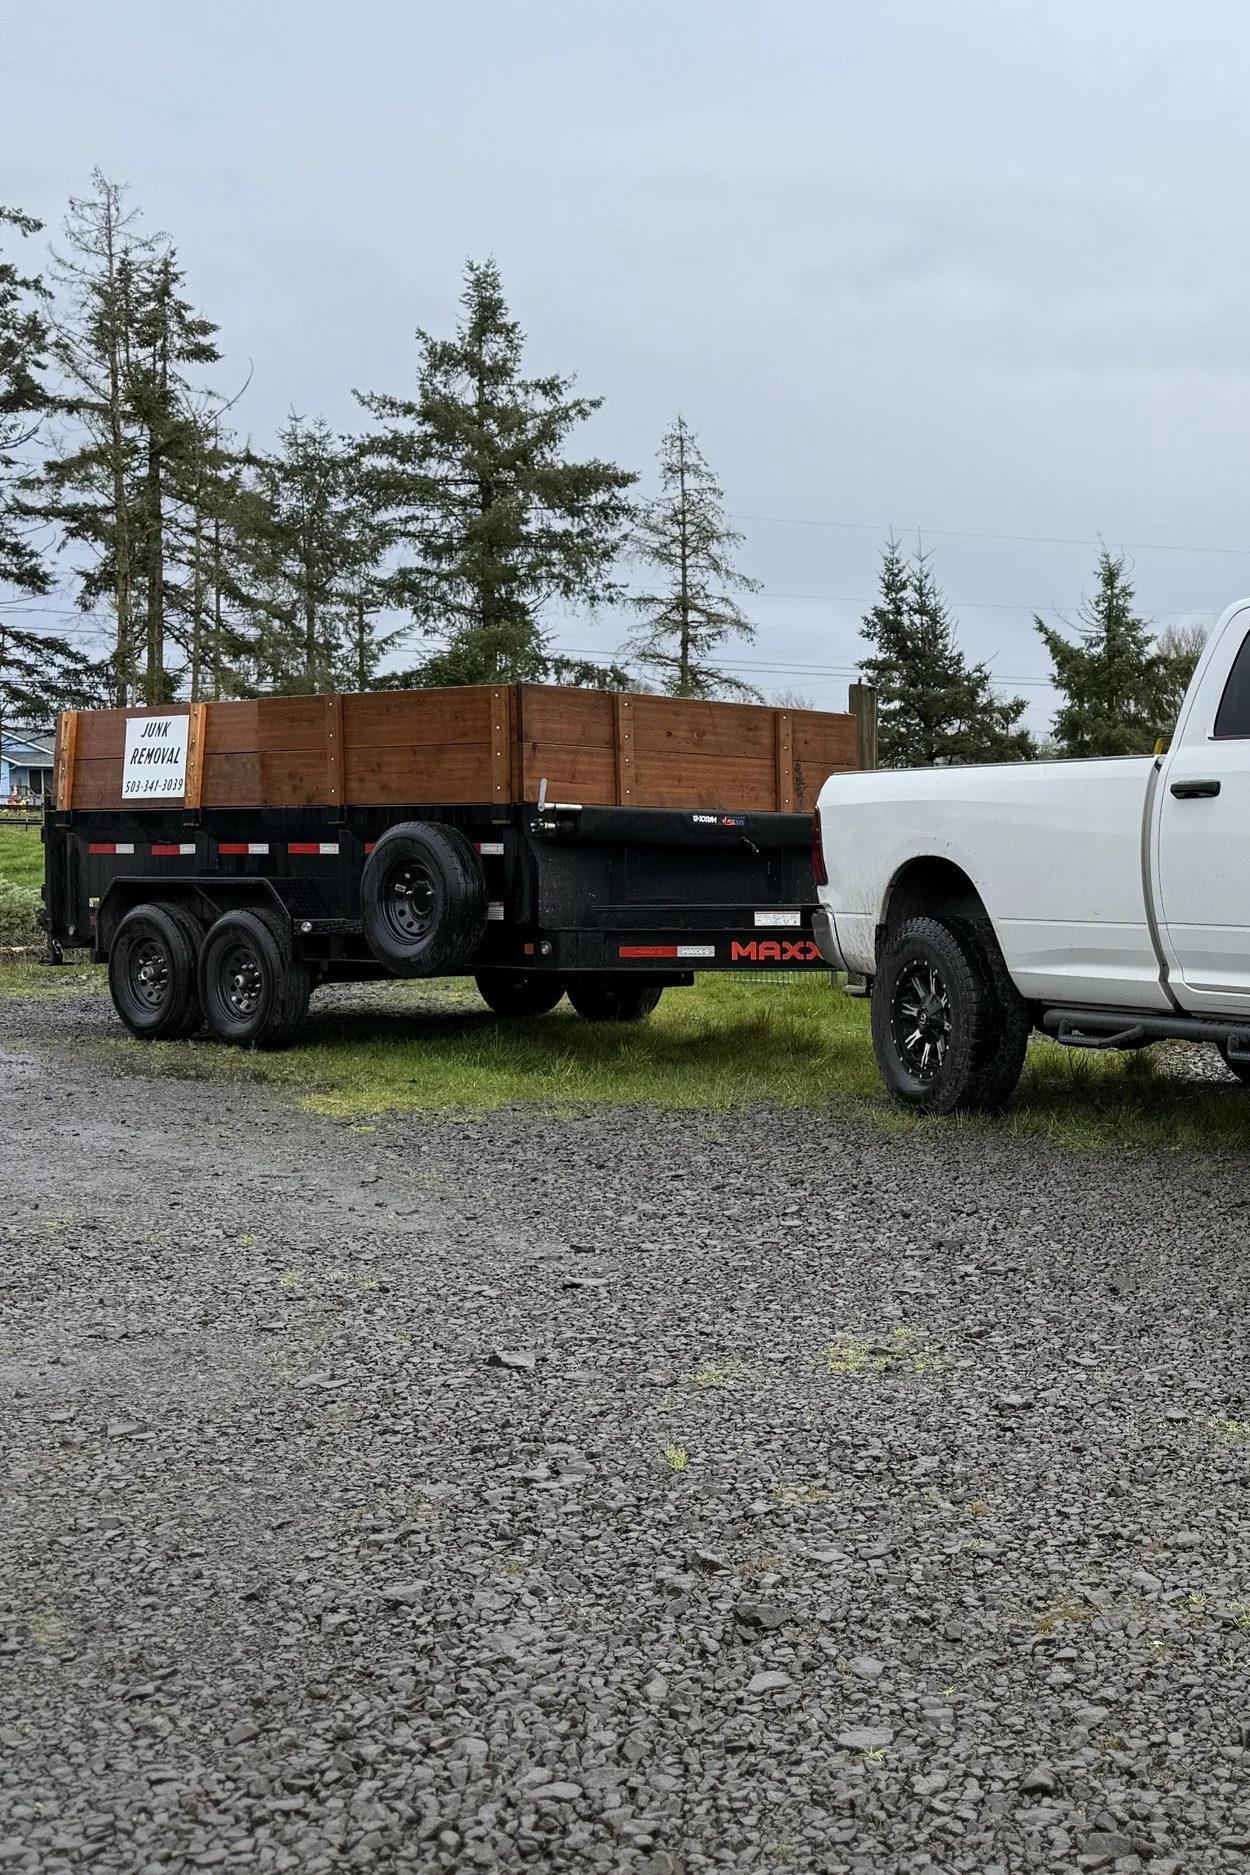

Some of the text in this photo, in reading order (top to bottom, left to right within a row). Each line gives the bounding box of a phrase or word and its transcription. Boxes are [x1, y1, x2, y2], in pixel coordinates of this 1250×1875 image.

[141, 721, 172, 738] JUNK
[130, 746, 181, 765] REMOVAL
[124, 778, 184, 793] 503-341-3039
